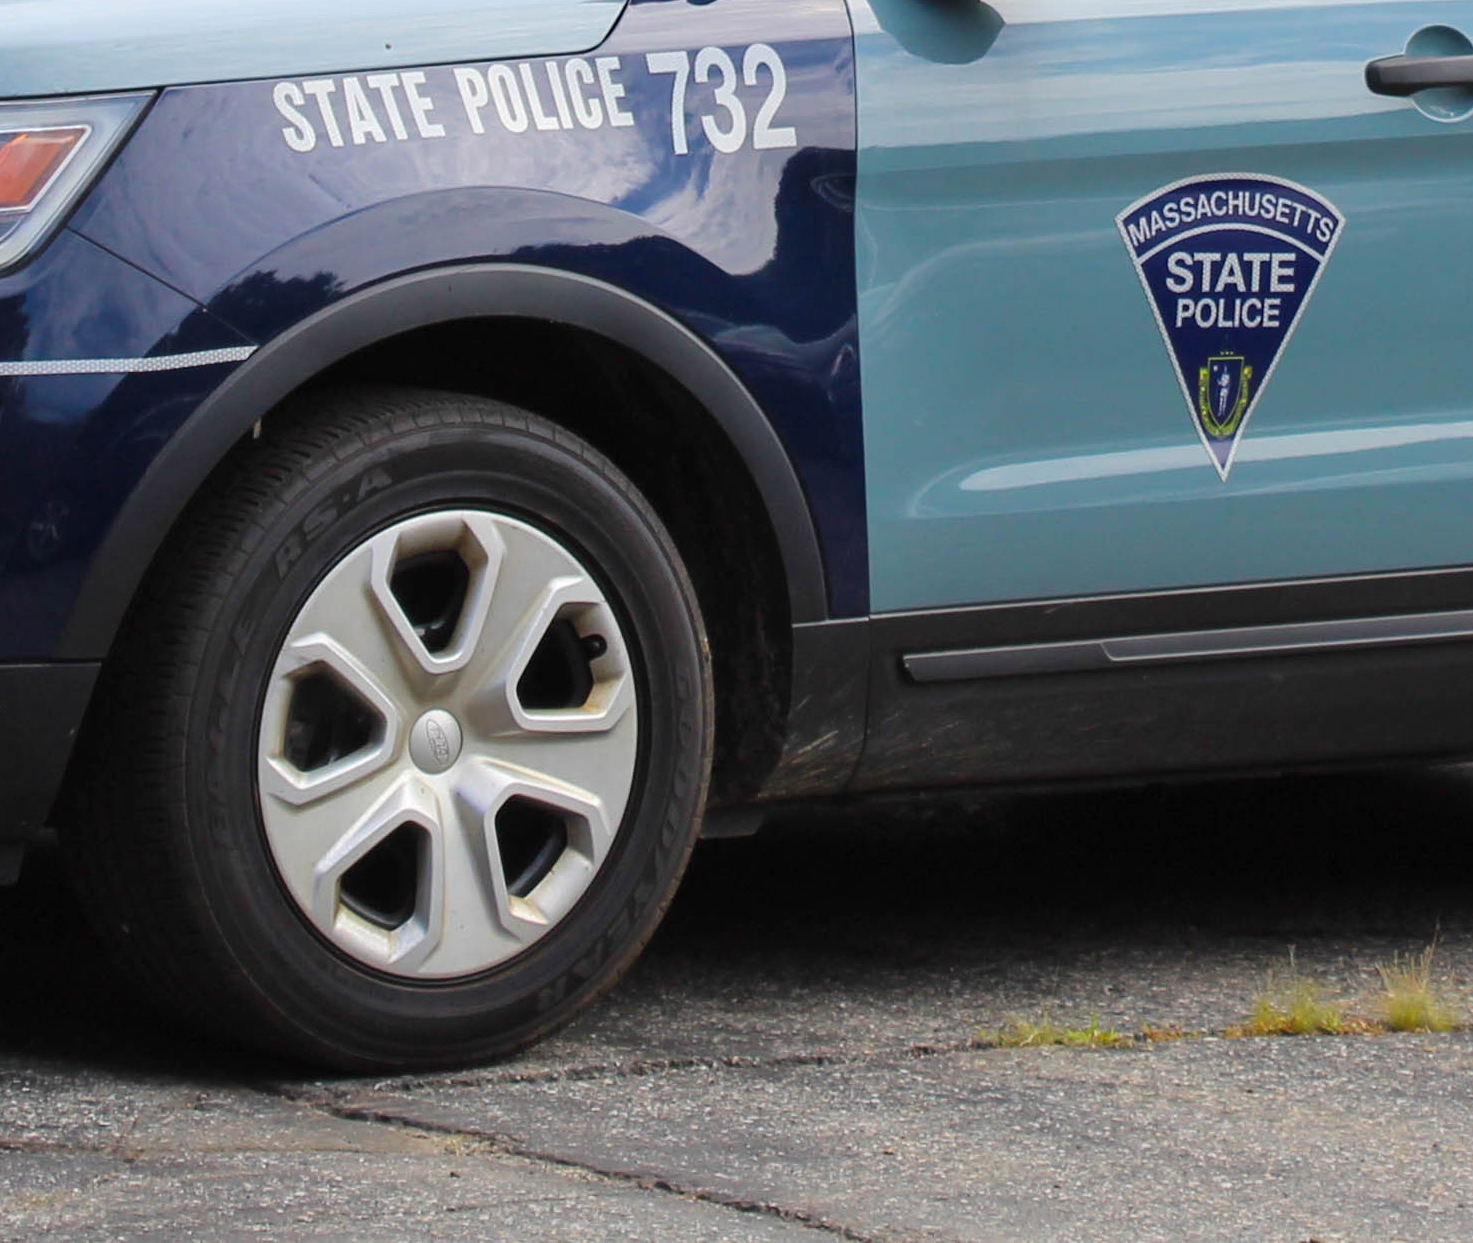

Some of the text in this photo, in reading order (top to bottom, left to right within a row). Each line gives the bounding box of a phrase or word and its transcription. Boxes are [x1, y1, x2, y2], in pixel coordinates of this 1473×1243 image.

[272, 43, 797, 155] STATE POLICE 732
[1127, 190, 1335, 248] MASSACHUSETTS
[1165, 252, 1296, 293] STATE
[1176, 298, 1281, 329] POLICE
